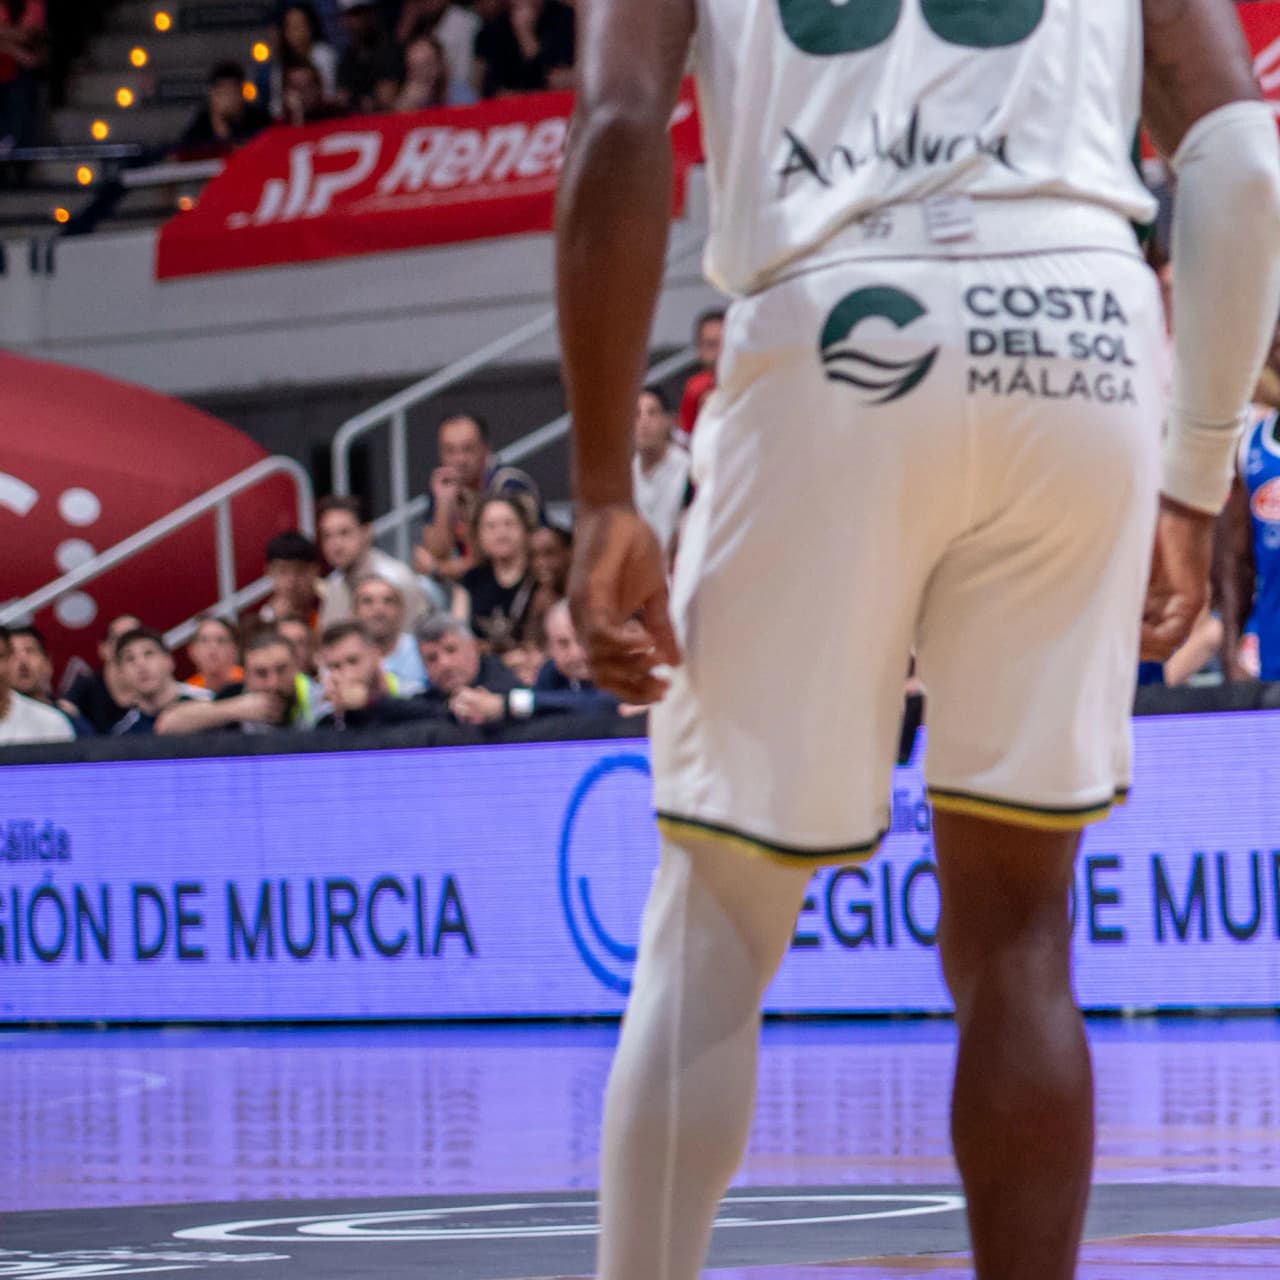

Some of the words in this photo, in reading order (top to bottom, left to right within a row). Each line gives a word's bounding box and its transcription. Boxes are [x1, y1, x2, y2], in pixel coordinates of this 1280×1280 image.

[965, 285, 1128, 326] COSTA
[966, 329, 1049, 359] DEL
[1067, 332, 1137, 367] SOL
[966, 358, 1138, 405] MÁLAGA
[0, 816, 71, 861] álida
[0, 872, 110, 962] IÓN
[131, 880, 207, 961] DE
[225, 874, 476, 960] MURCIA
